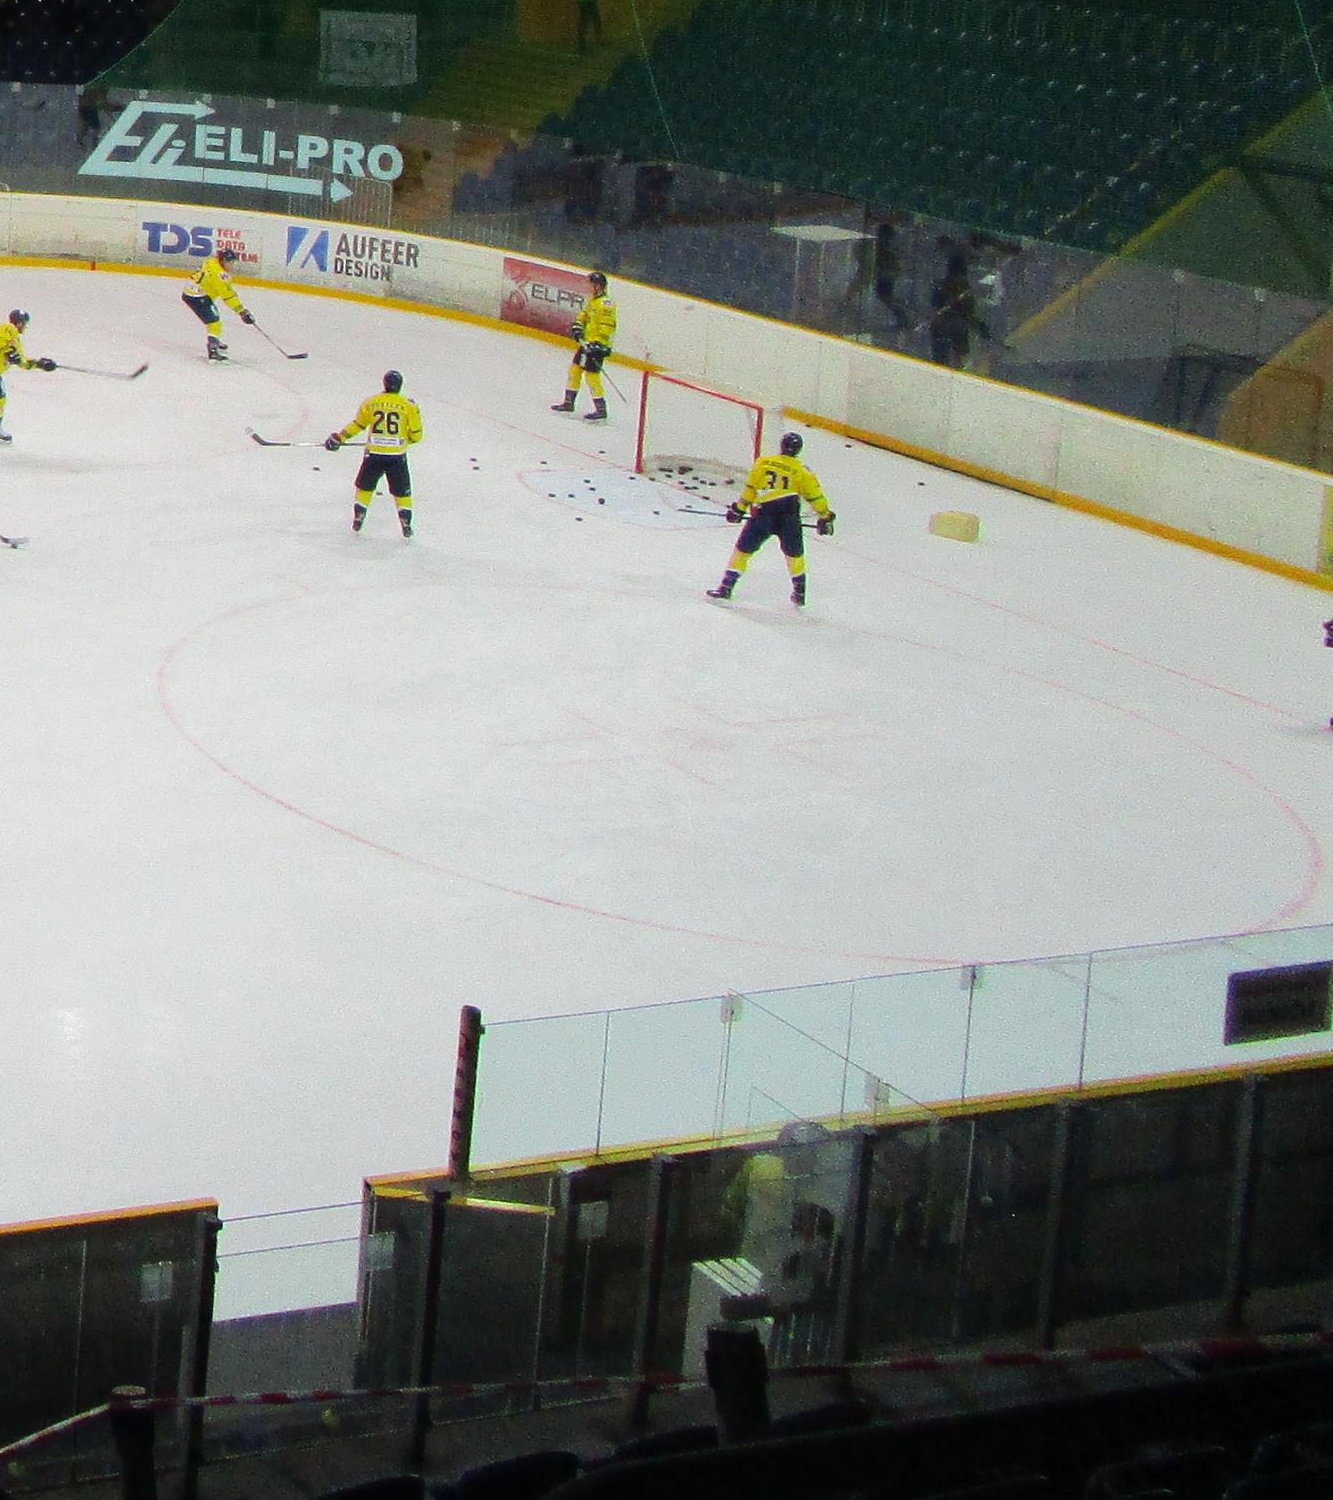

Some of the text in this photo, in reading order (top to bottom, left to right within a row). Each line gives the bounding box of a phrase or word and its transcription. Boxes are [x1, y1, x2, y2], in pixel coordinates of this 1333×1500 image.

[194, 124, 405, 182] ELI-PRO
[141, 222, 214, 257] TDS
[216, 228, 242, 240] TELE
[216, 239, 246, 251] DATA
[335, 233, 421, 269] AUFEER
[334, 258, 391, 282] DESIGN
[372, 410, 400, 435] 26
